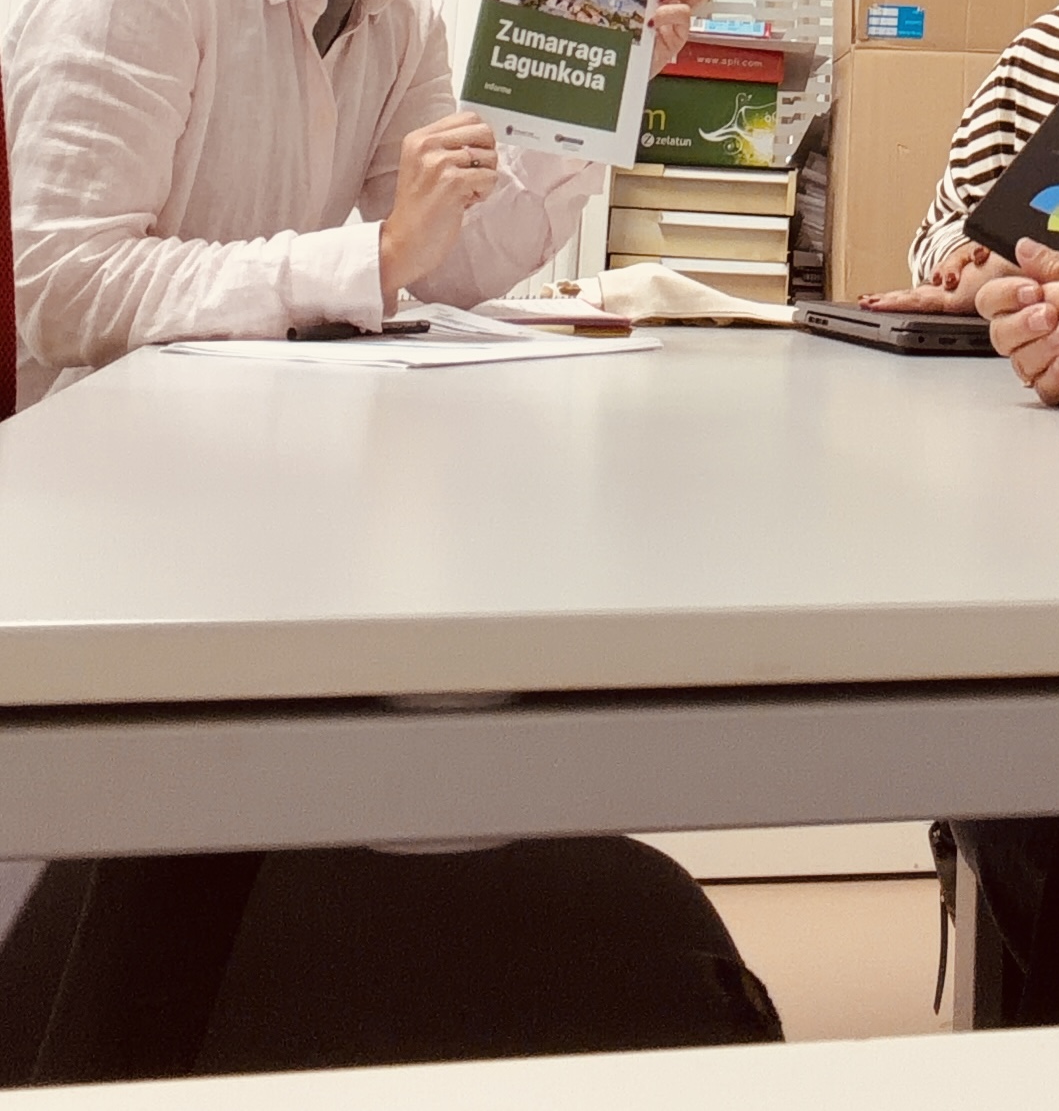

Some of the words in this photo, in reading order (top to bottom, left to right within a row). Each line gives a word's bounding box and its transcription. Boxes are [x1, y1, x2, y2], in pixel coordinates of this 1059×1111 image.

[496, 18, 617, 68] Zumarraga
[490, 45, 605, 91] Lagunkoia
[655, 135, 692, 147] zelatun
